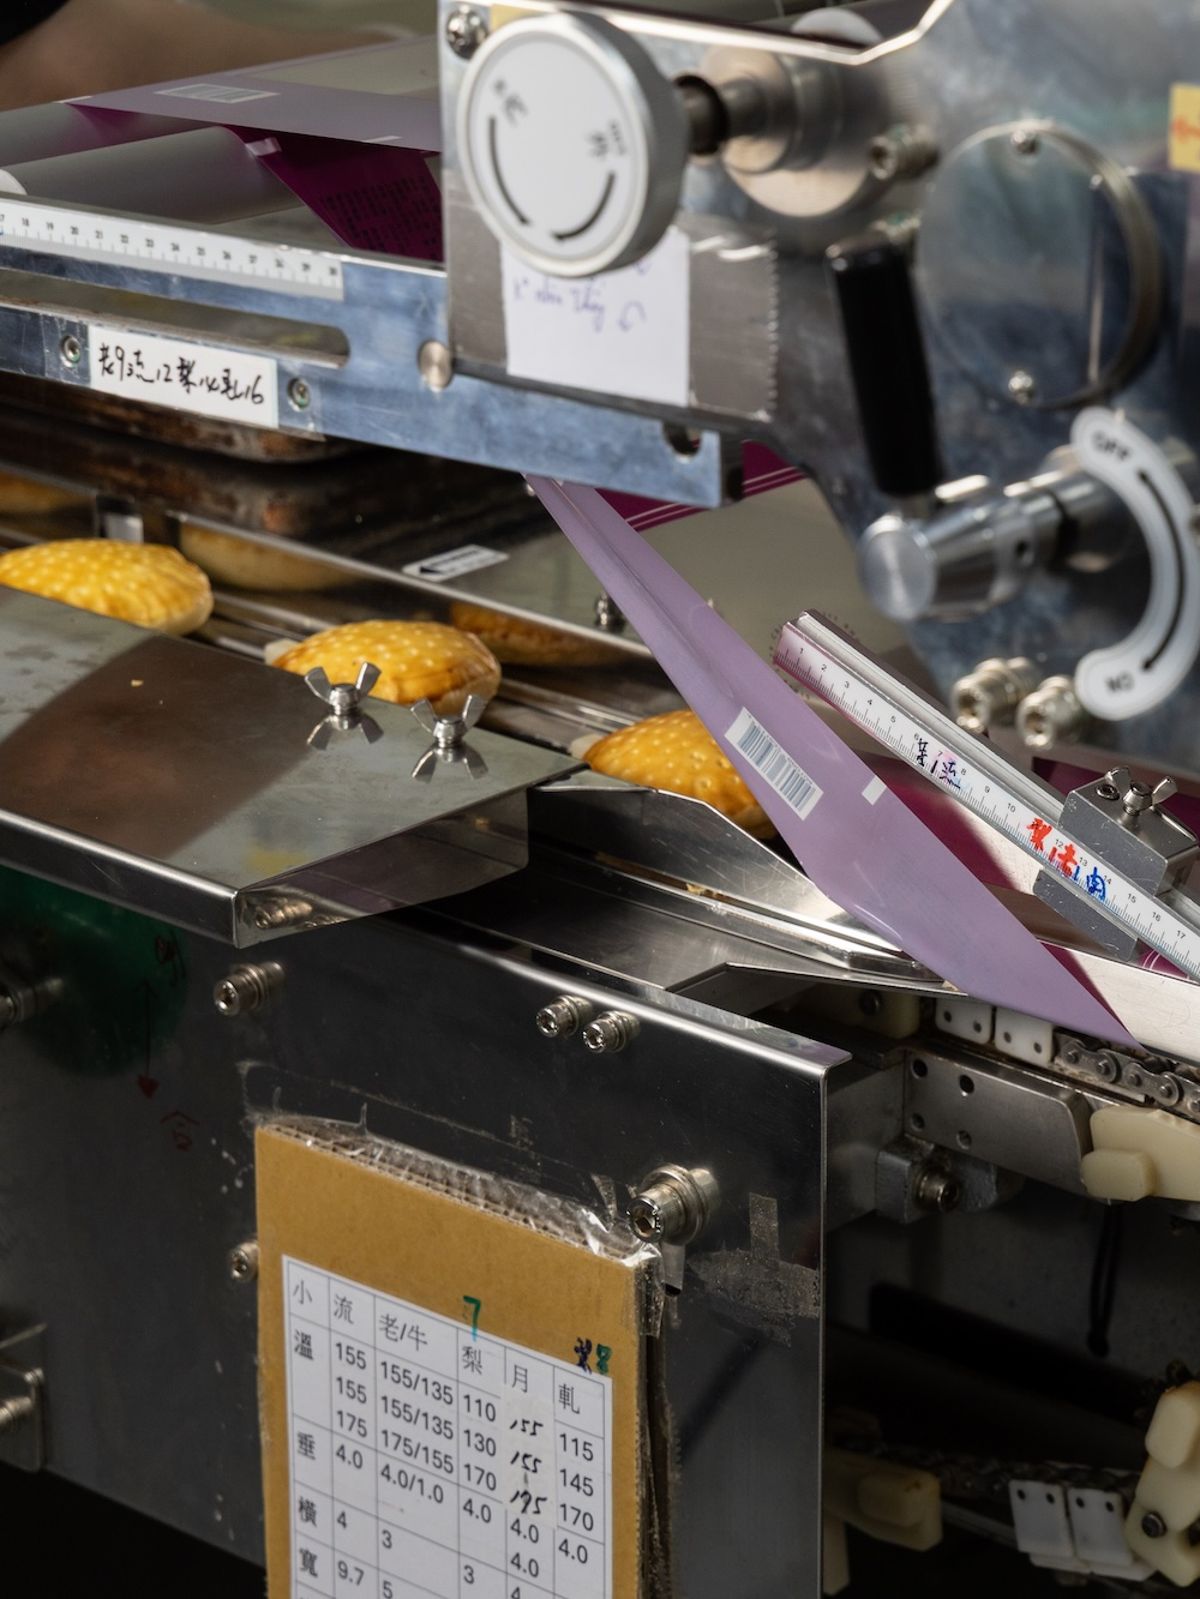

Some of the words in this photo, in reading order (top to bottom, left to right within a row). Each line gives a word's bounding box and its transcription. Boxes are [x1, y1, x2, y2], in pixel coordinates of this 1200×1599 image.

[844, 681, 850, 689] 3
[891, 716, 896, 724] 5
[961, 767, 967, 776] 8
[985, 785, 990, 794] 9
[1007, 803, 1017, 813] 10
[1055, 838, 1064, 848] 12
[1079, 857, 1088, 866] 13
[1103, 875, 1112, 885] 14
[1127, 893, 1137, 904] 15
[1152, 911, 1162, 922] 16
[1176, 930, 1187, 940] 17
[293, 1279, 313, 1305] 小
[334, 1294, 354, 1325] 流
[379, 1313, 428, 1352] 老/牛
[462, 1346, 483, 1375] 梨
[512, 1364, 528, 1393] 月
[559, 1383, 581, 1414] 軋
[336, 1342, 366, 1370] 155
[381, 1361, 453, 1405] 155/135
[464, 1394, 496, 1422] 110
[560, 1433, 594, 1462] 115
[336, 1376, 367, 1404] 155
[381, 1395, 453, 1440] 155/135
[464, 1429, 496, 1457] 130
[560, 1468, 594, 1497] 145
[337, 1410, 367, 1438] 175
[382, 1429, 454, 1474] 175/155
[464, 1463, 497, 1491] 170
[560, 1503, 594, 1532] 170
[297, 1431, 316, 1460] 垂
[336, 1444, 363, 1470] 4.0
[380, 1463, 444, 1504] 4.0/1.0
[463, 1498, 491, 1524] 4.0
[511, 1518, 539, 1544] 4.0
[558, 1538, 588, 1564] 4.0
[337, 1511, 347, 1529] 4
[382, 1529, 392, 1549] 3
[464, 1564, 475, 1584] 3
[337, 1560, 364, 1586] 9.7
[382, 1580, 393, 1599] 5
[511, 1552, 539, 1578] 4.0
